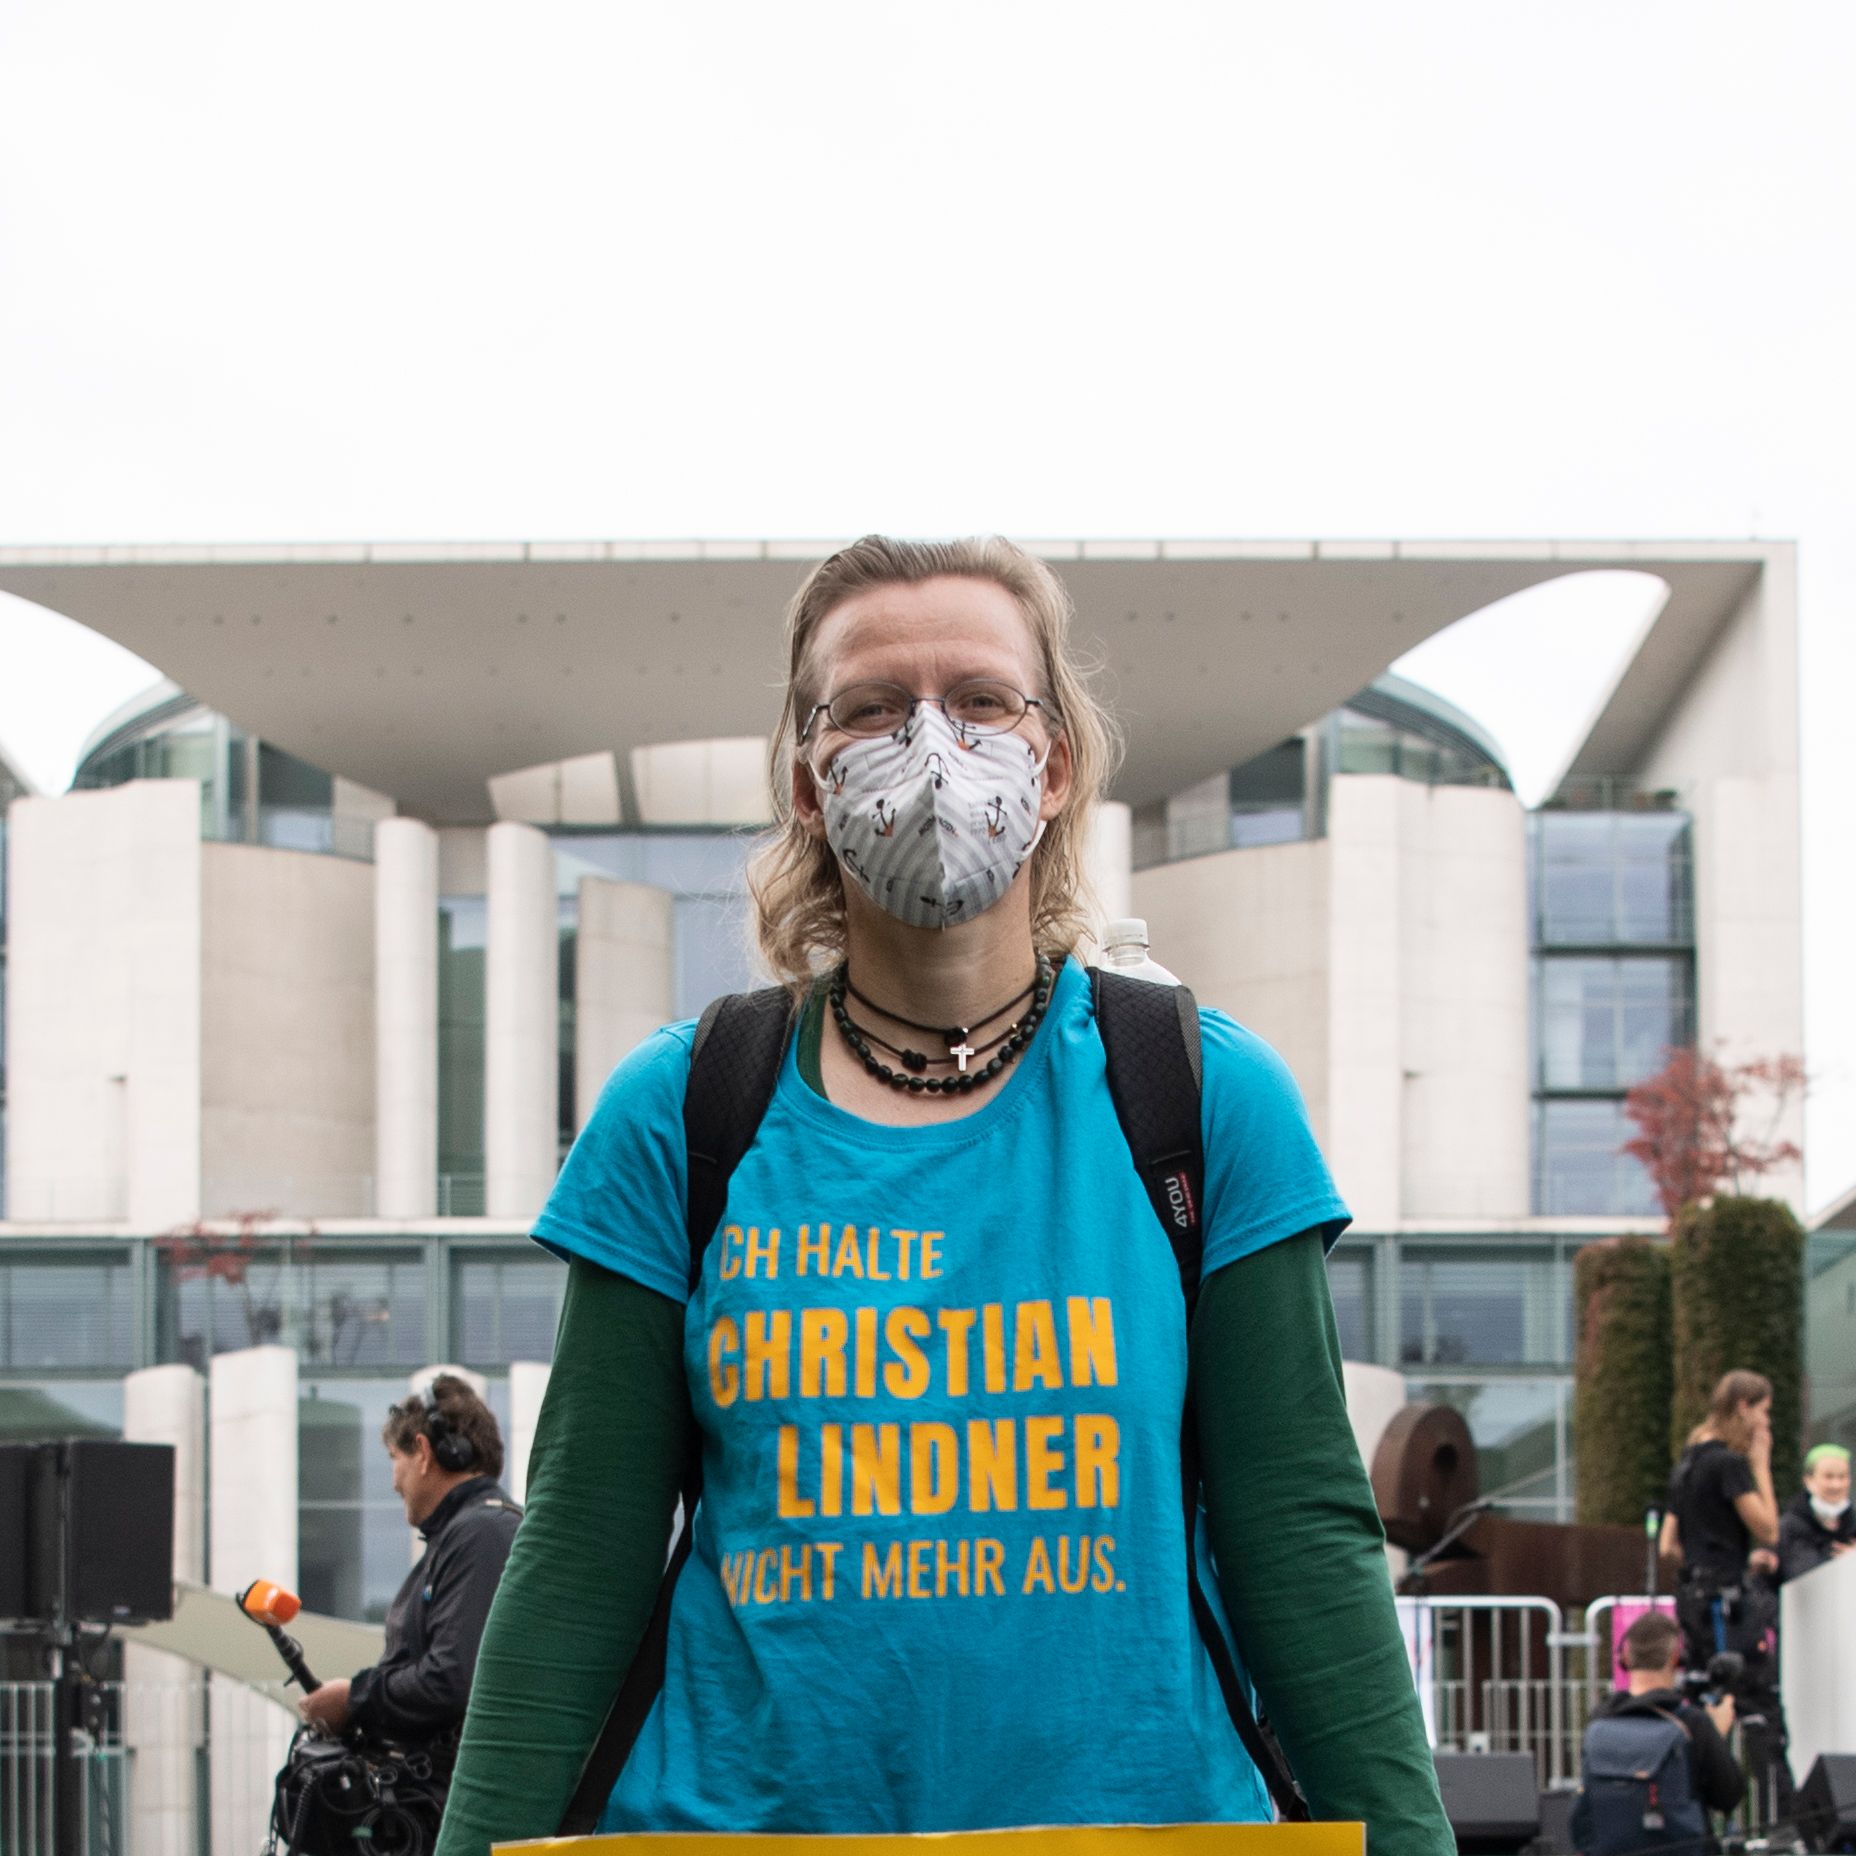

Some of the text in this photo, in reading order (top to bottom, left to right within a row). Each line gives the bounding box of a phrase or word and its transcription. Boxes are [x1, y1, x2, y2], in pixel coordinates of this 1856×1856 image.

[1164, 1177, 1188, 1228] 4YOU
[719, 1222, 945, 1281] CH HALTE
[708, 1296, 1119, 1408] CHRISTIAN
[777, 1414, 1121, 1519] LINDNER
[720, 1535, 1126, 1606] NICHT MEHR AUS.
